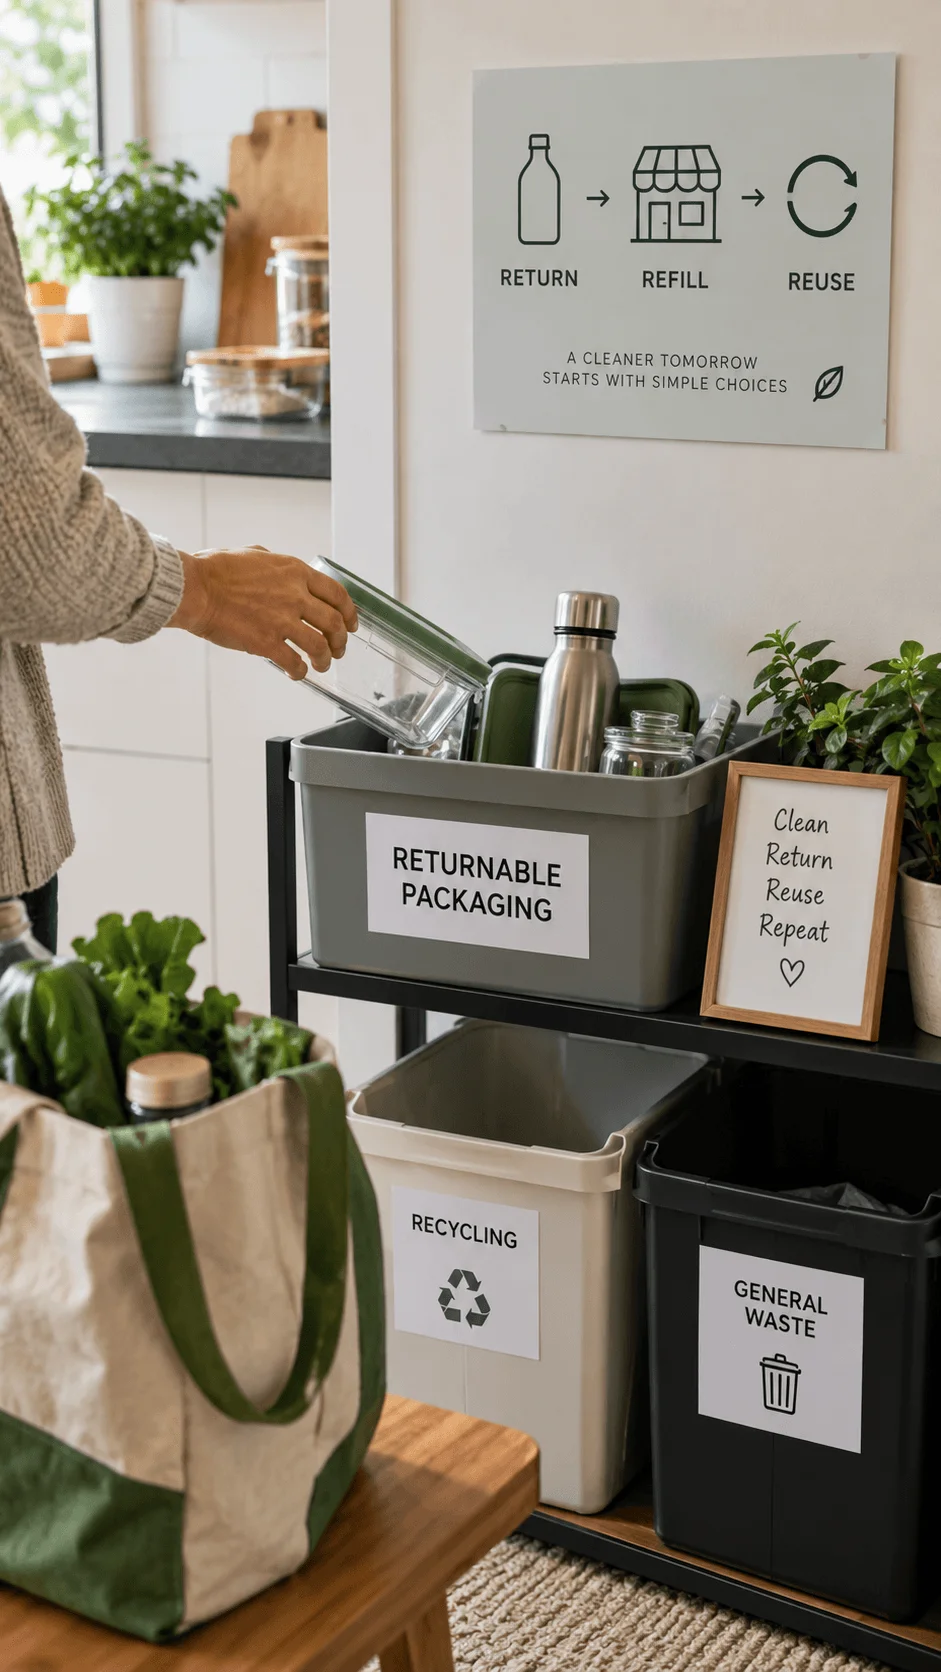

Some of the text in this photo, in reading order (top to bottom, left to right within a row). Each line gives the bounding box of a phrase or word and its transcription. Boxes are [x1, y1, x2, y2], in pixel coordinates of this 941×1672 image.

[501, 268, 577, 287] RETURN
[642, 270, 709, 289] REFILL
[788, 271, 856, 292] REUSE
[567, 351, 758, 370] A CLEANER TOMORROW
[542, 371, 788, 393] STARTS WITH SIMPLE CHOICES
[774, 807, 829, 834] Clean
[393, 846, 562, 888] RETURNABLE
[765, 841, 833, 870] Return
[402, 881, 552, 923] PACKAGING
[766, 877, 825, 905] Reuse
[759, 912, 830, 948] Repeat
[411, 1213, 518, 1250] RECYCLING
[733, 1279, 829, 1316] GENERAL
[744, 1306, 816, 1339] WASTE
